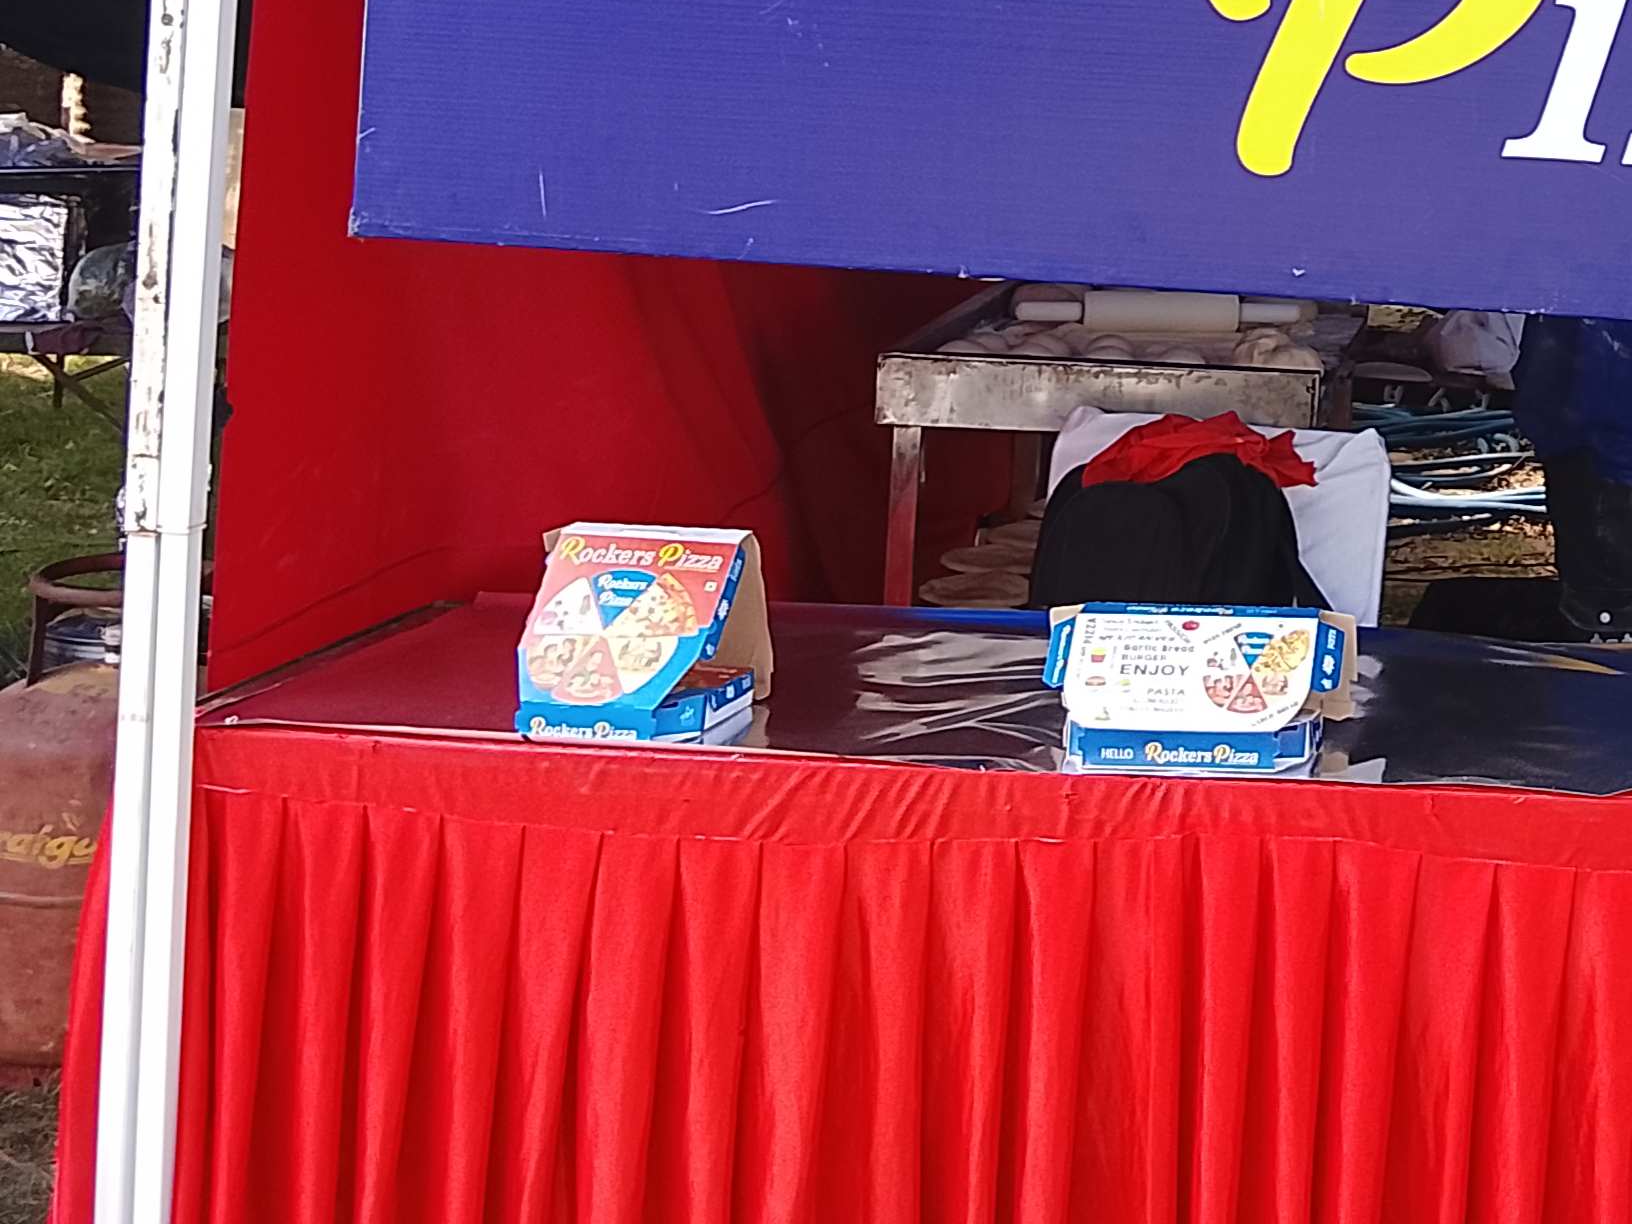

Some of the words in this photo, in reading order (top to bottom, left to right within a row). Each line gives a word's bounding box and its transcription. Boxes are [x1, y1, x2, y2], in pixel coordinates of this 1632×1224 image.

[559, 535, 656, 566] Rockers
[658, 543, 724, 571] Pizza
[1120, 664, 1190, 676] ENJOY
[530, 716, 594, 738] Rockers
[1101, 747, 1134, 760] HELLO
[1145, 742, 1212, 765] Rockers
[1213, 744, 1259, 766] Pizza
